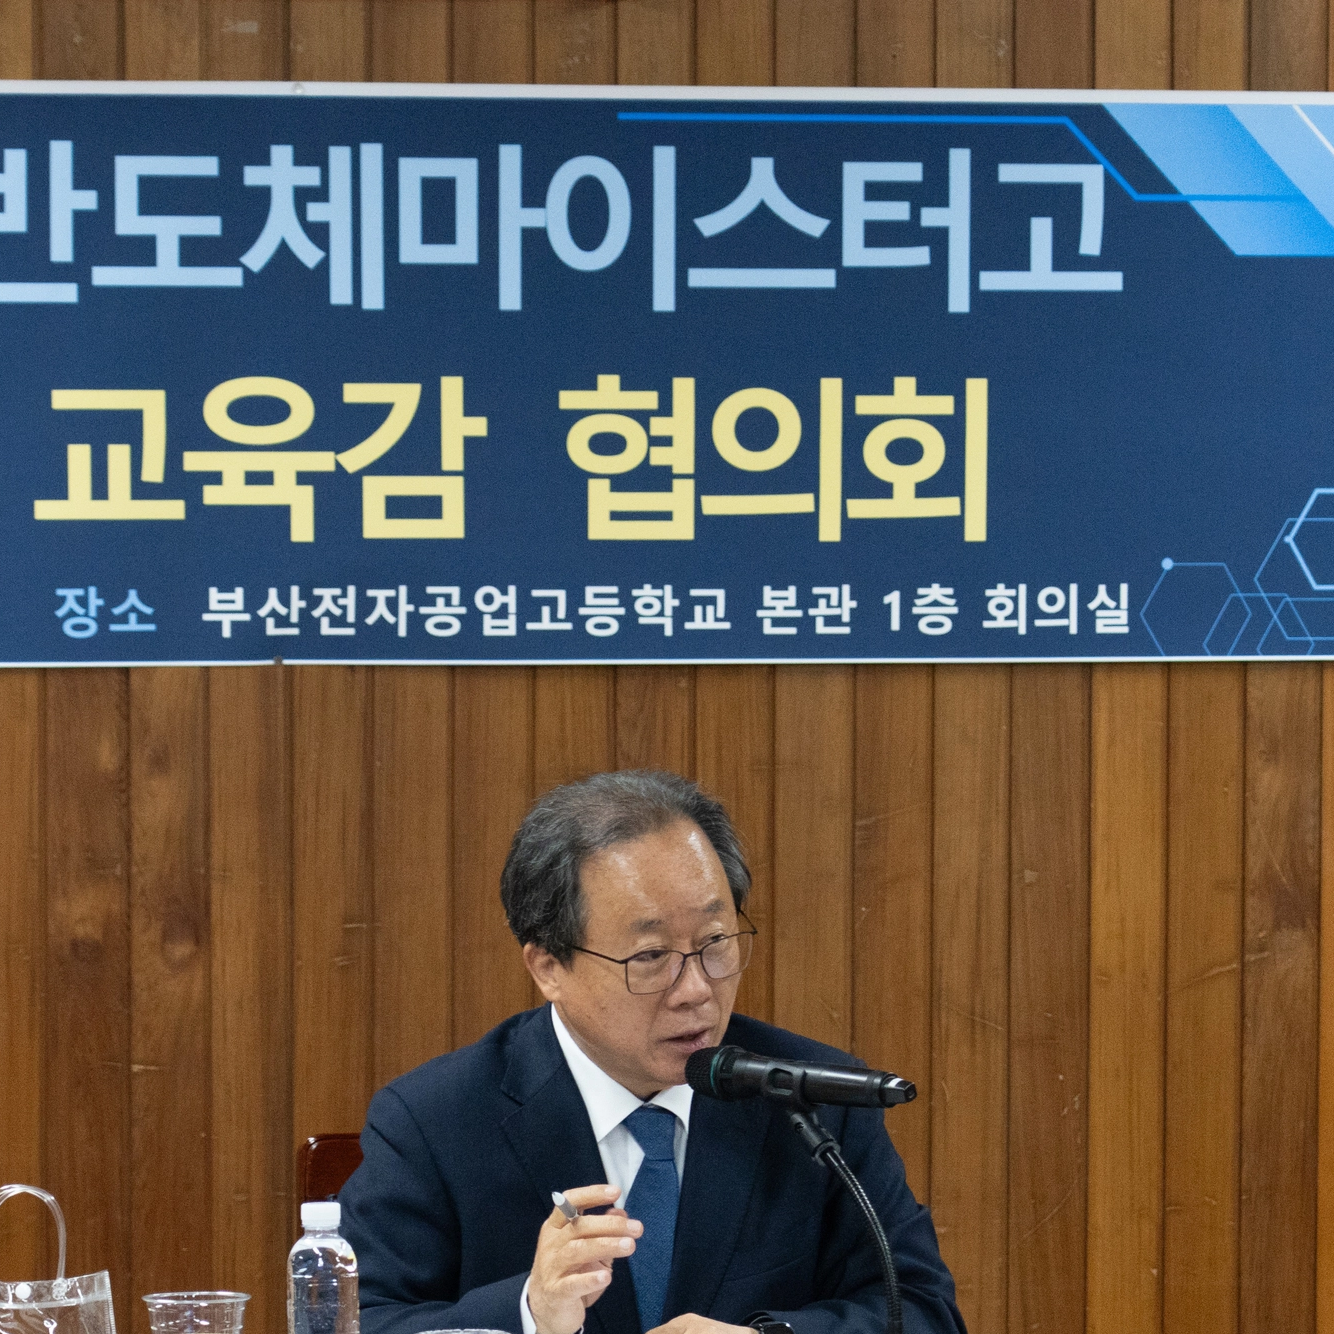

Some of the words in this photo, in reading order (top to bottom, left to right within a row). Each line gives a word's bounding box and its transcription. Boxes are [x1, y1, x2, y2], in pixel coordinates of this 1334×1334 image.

[34, 375, 488, 543] 교육감
[558, 374, 988, 542] 협의회
[56, 588, 154, 637] 장소
[201, 583, 731, 638] 부산전자공업고등학교
[755, 584, 857, 635] 본관
[883, 583, 959, 636] 1층
[982, 583, 1130, 635] 회의실
